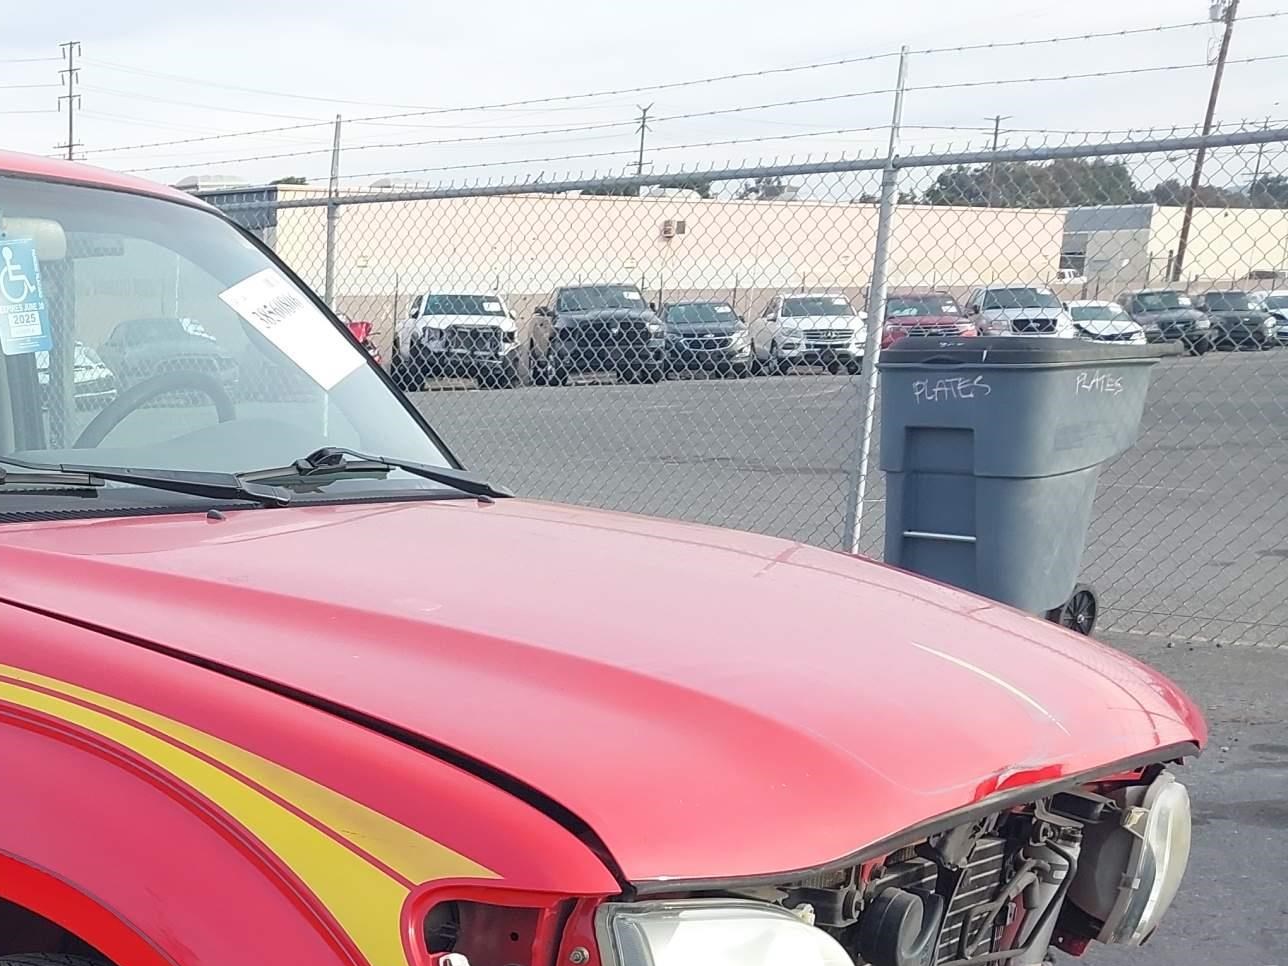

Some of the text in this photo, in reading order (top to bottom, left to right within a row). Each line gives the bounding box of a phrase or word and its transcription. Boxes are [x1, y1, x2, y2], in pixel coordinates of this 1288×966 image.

[13, 313, 36, 325] 2025
[913, 375, 991, 405] PLATES
[1076, 370, 1123, 395] PLATES
